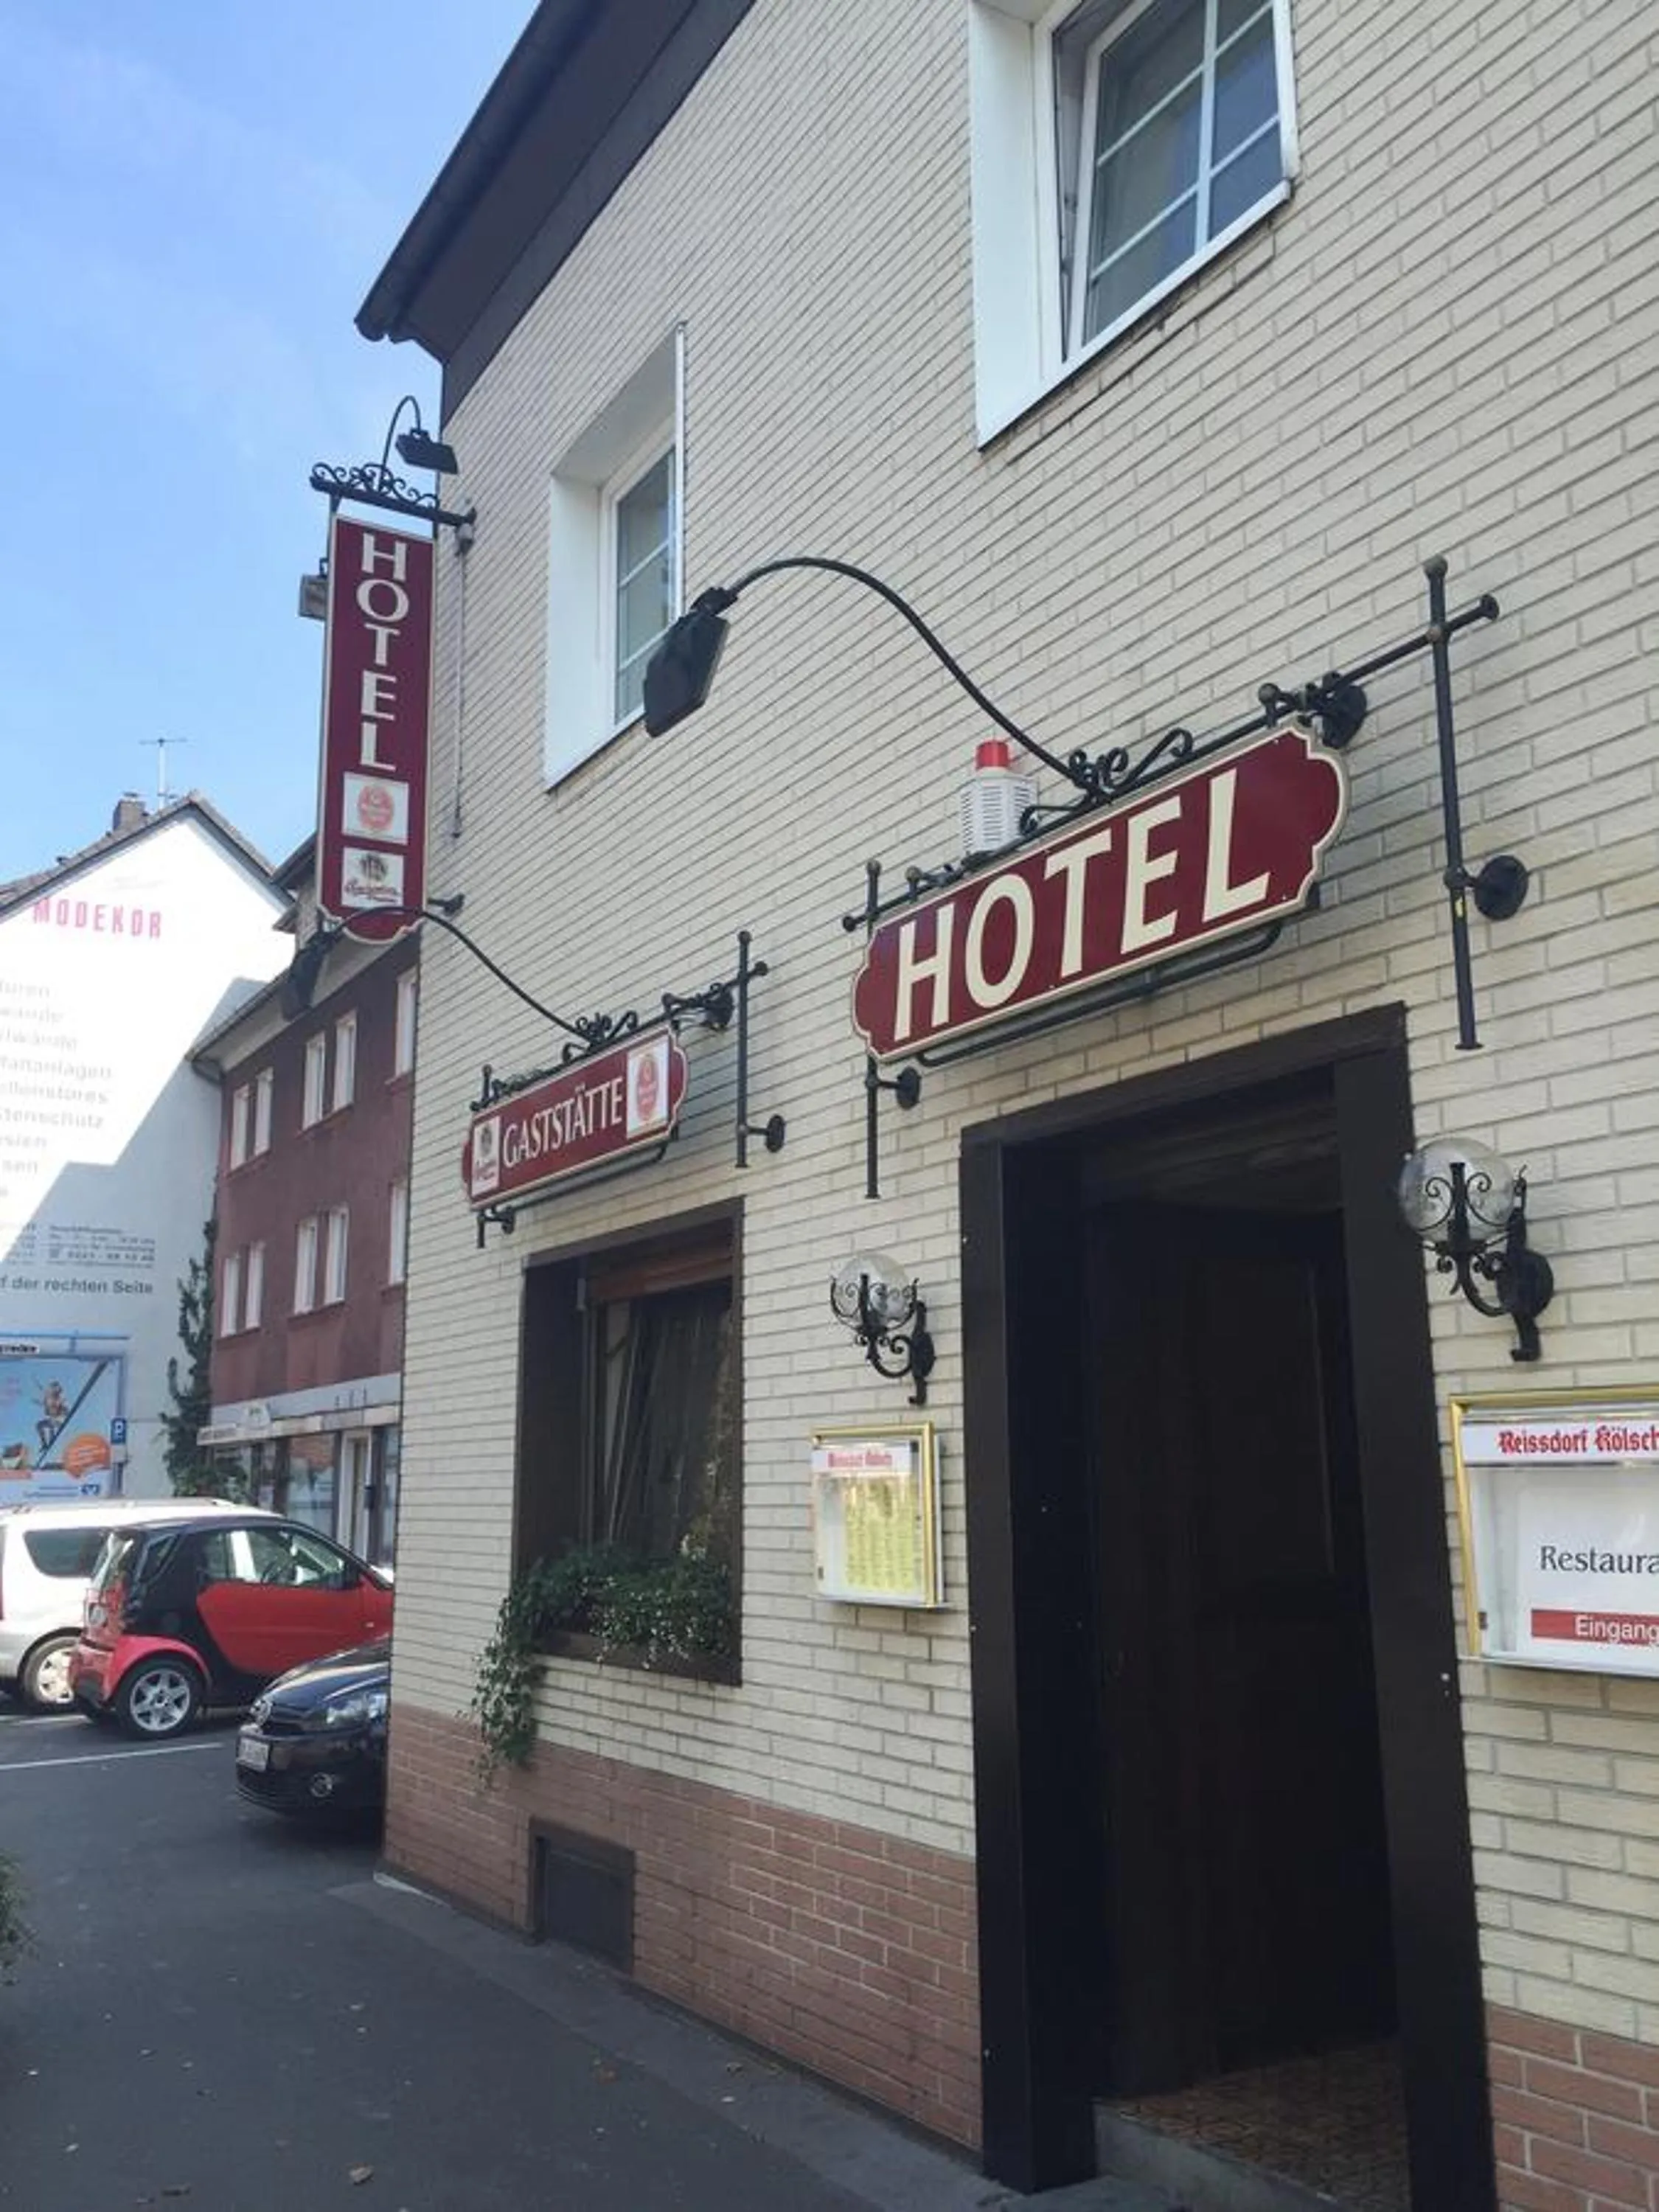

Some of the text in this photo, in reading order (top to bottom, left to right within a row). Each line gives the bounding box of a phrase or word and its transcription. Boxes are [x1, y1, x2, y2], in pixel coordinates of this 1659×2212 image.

[356, 532, 409, 771] HOTEL
[893, 768, 1270, 1042] HOTEL
[503, 1077, 625, 1168] GASTSTÄTTE
[12, 1275, 40, 1290] der
[44, 1277, 107, 1294] rechten
[113, 1280, 153, 1294] Seite
[1498, 1429, 1588, 1454] Reissdorf
[1540, 1545, 1659, 1573] Restaura
[1575, 1614, 1659, 1646] Eingang
